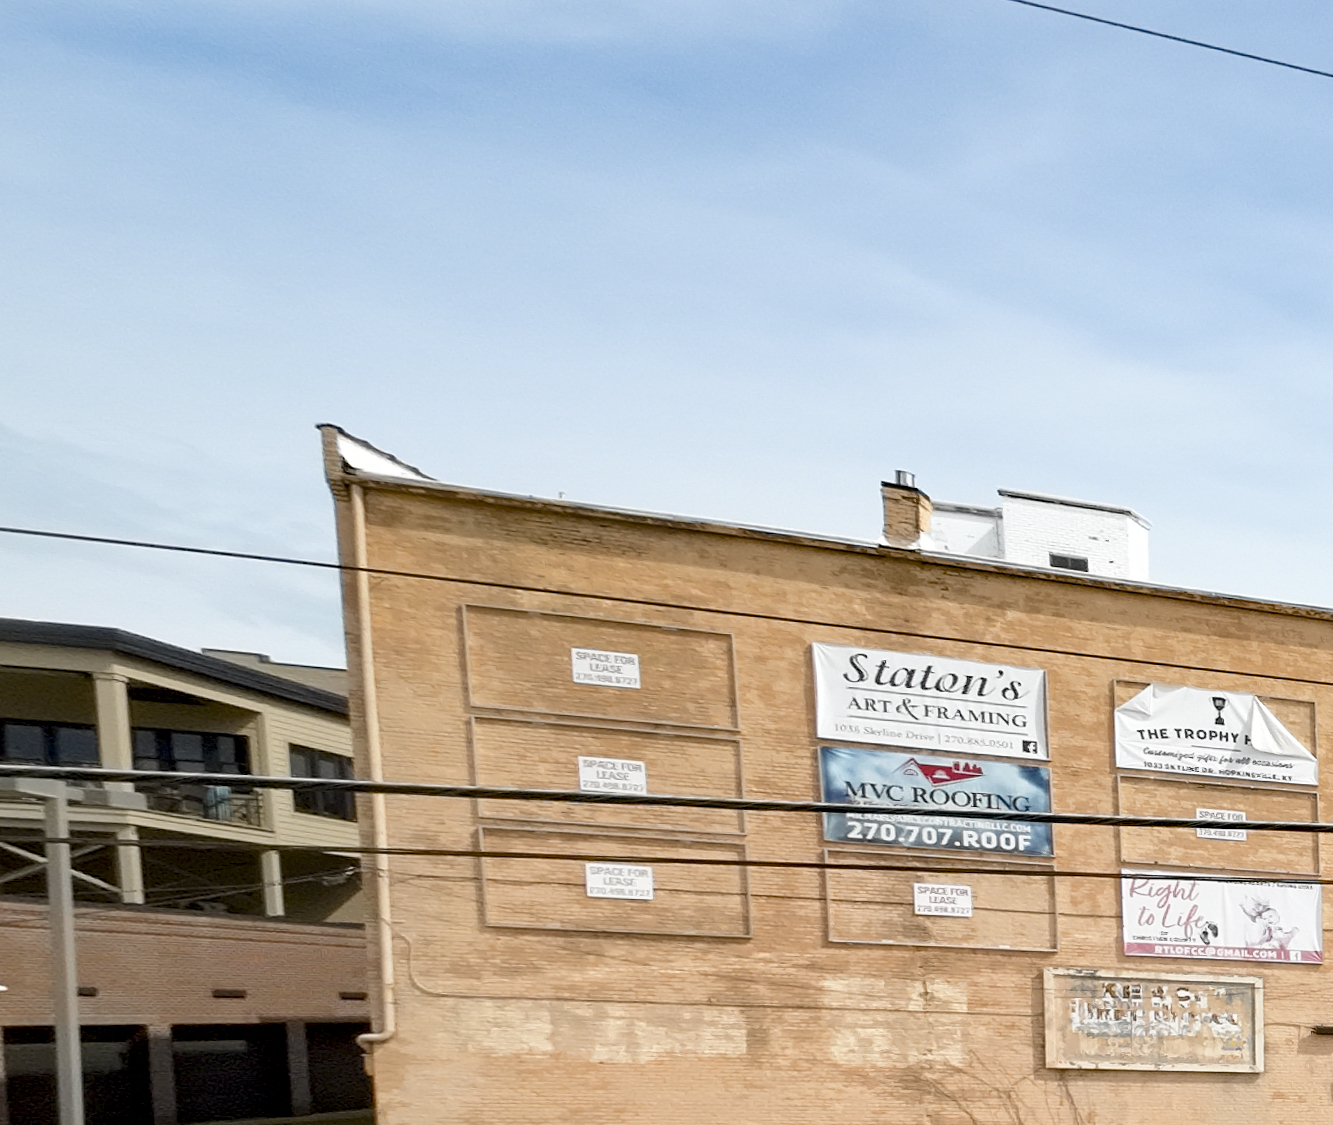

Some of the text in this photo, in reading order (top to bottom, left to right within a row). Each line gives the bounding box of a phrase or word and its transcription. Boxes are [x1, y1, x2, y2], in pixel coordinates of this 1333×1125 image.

[576, 651, 636, 665] SPACE FOR
[590, 663, 623, 674] LEASE
[843, 653, 1029, 701] Staton's
[847, 697, 1028, 728] ART & FRAMING
[863, 726, 902, 739] Skyline
[905, 730, 935, 742] Drive
[1137, 728, 1169, 741] THE
[1174, 728, 1240, 743] TROPHY
[1143, 746, 1195, 762] Customized
[583, 759, 642, 772] SPACE FOR
[596, 770, 630, 781] LEASE
[1282, 774, 1293, 782] KY
[844, 781, 1032, 812] MVC ROOFING
[1199, 810, 1244, 821] SPACE FOR
[846, 821, 1032, 851] 270.707.ROOF
[589, 866, 649, 878] SPACE FOR
[603, 877, 637, 887] LEASE
[917, 886, 969, 897] SPACE FOR
[1129, 877, 1201, 908] Right
[928, 896, 957, 905] LEASE
[1138, 904, 1206, 938] to Life
[1154, 945, 1277, 959] RTLOFCC@GMAIL.COM
